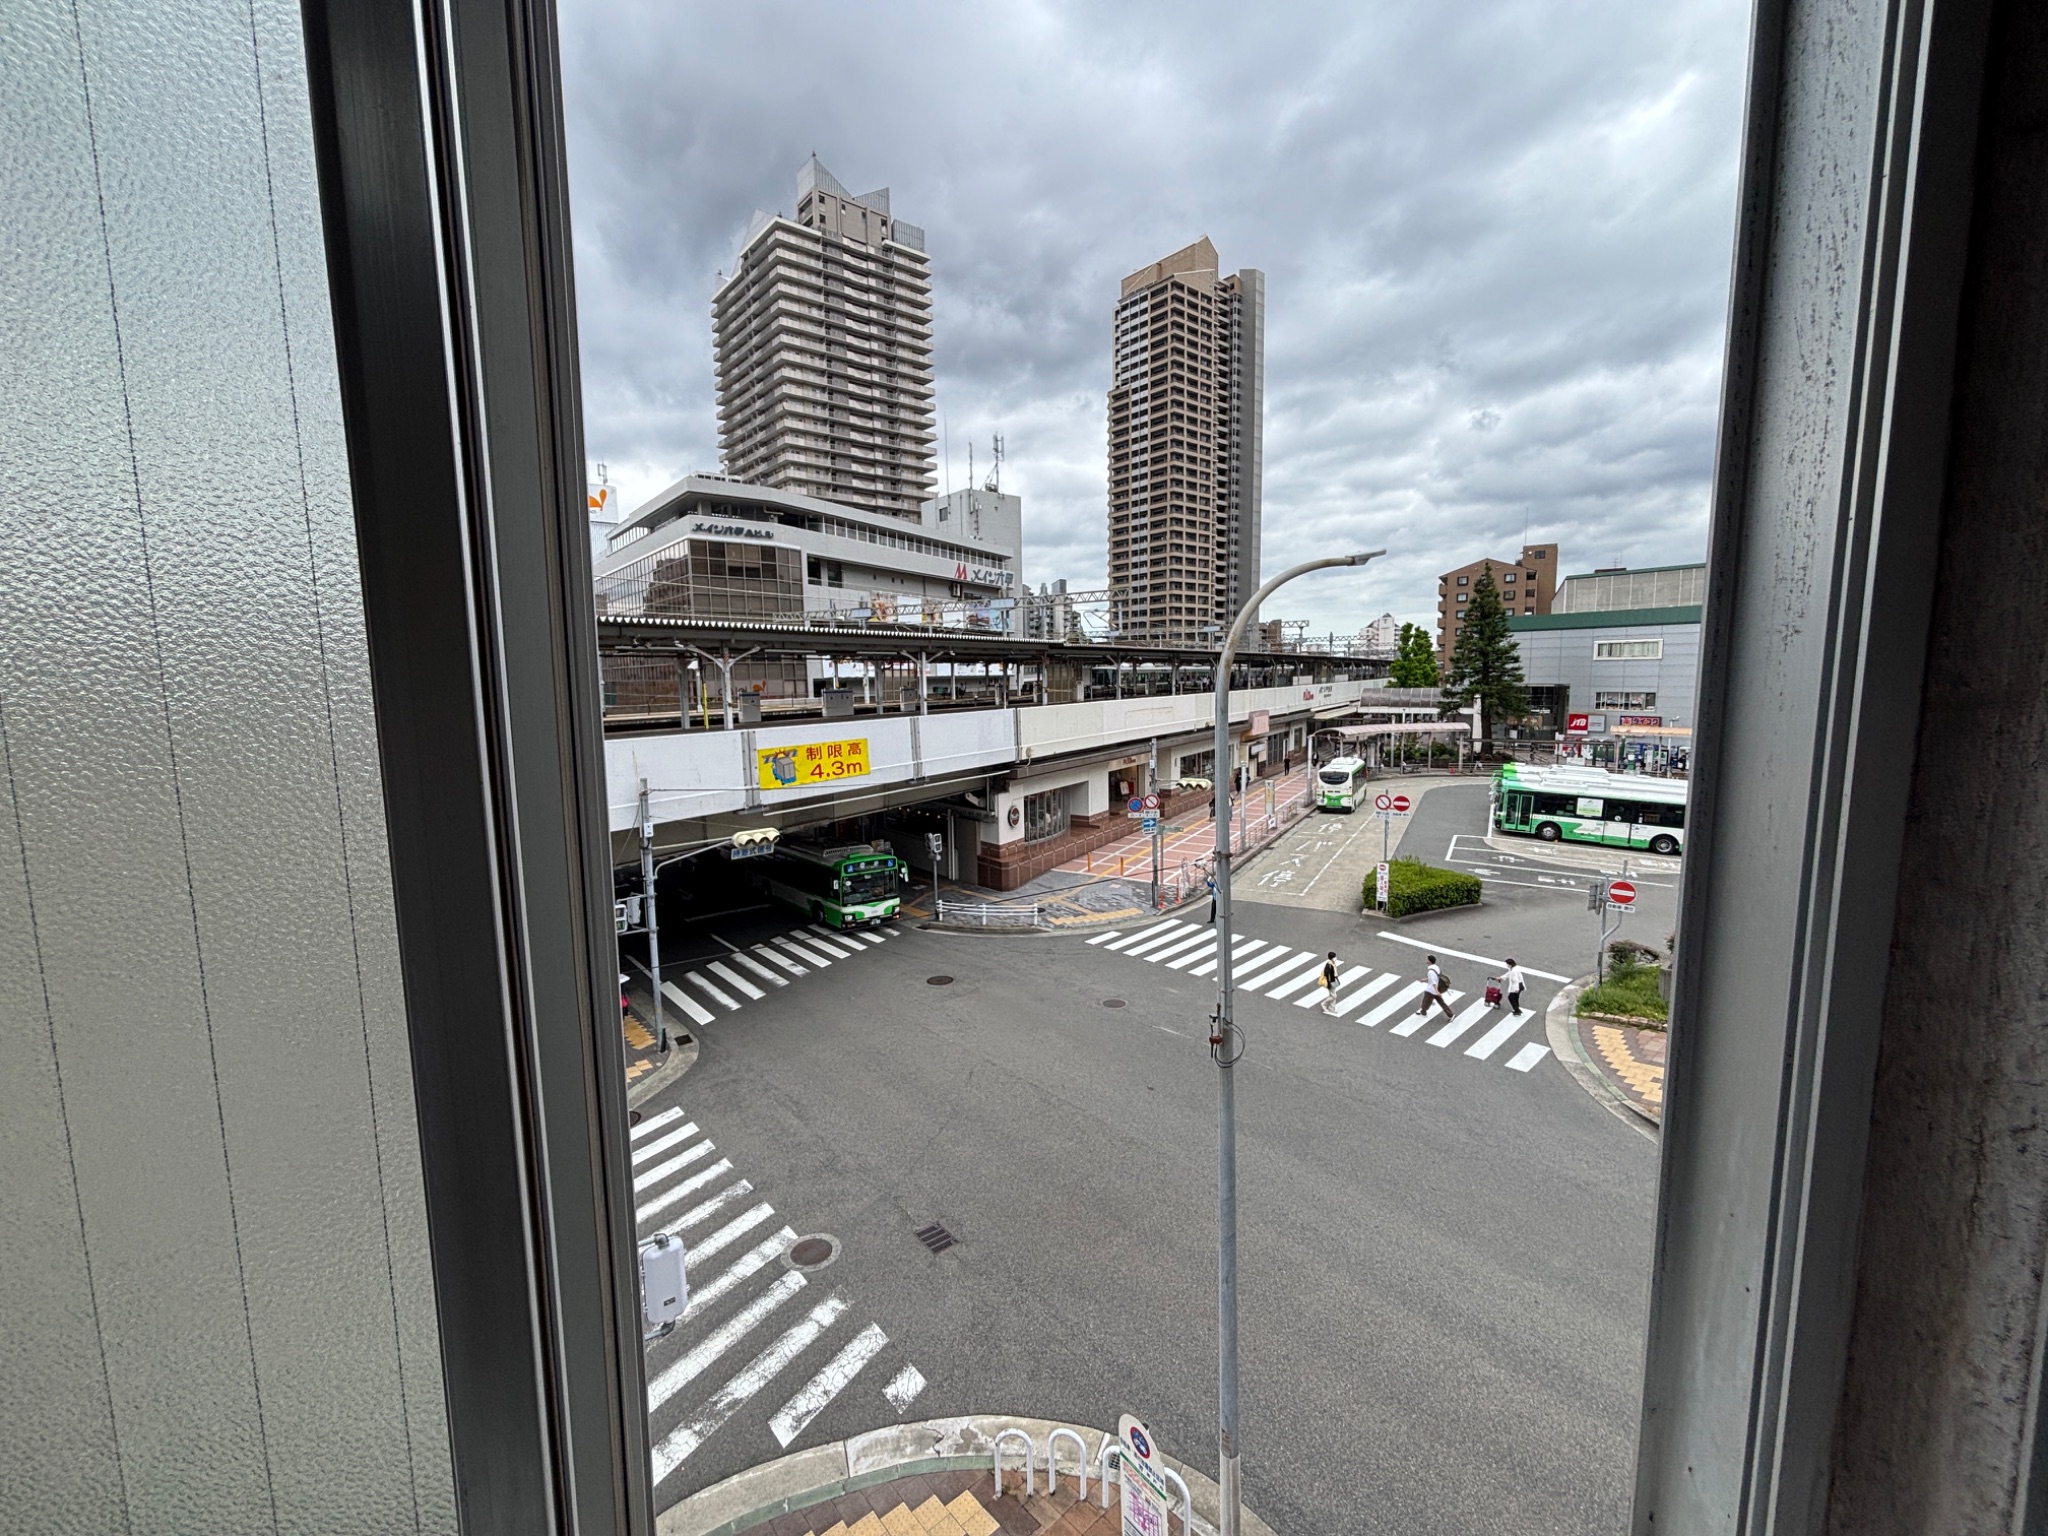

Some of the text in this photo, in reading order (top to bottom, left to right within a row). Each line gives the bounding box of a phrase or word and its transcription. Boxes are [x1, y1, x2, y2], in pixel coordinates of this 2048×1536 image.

[806, 742, 862, 761] 制限高
[810, 761, 863, 778] 4.3m
